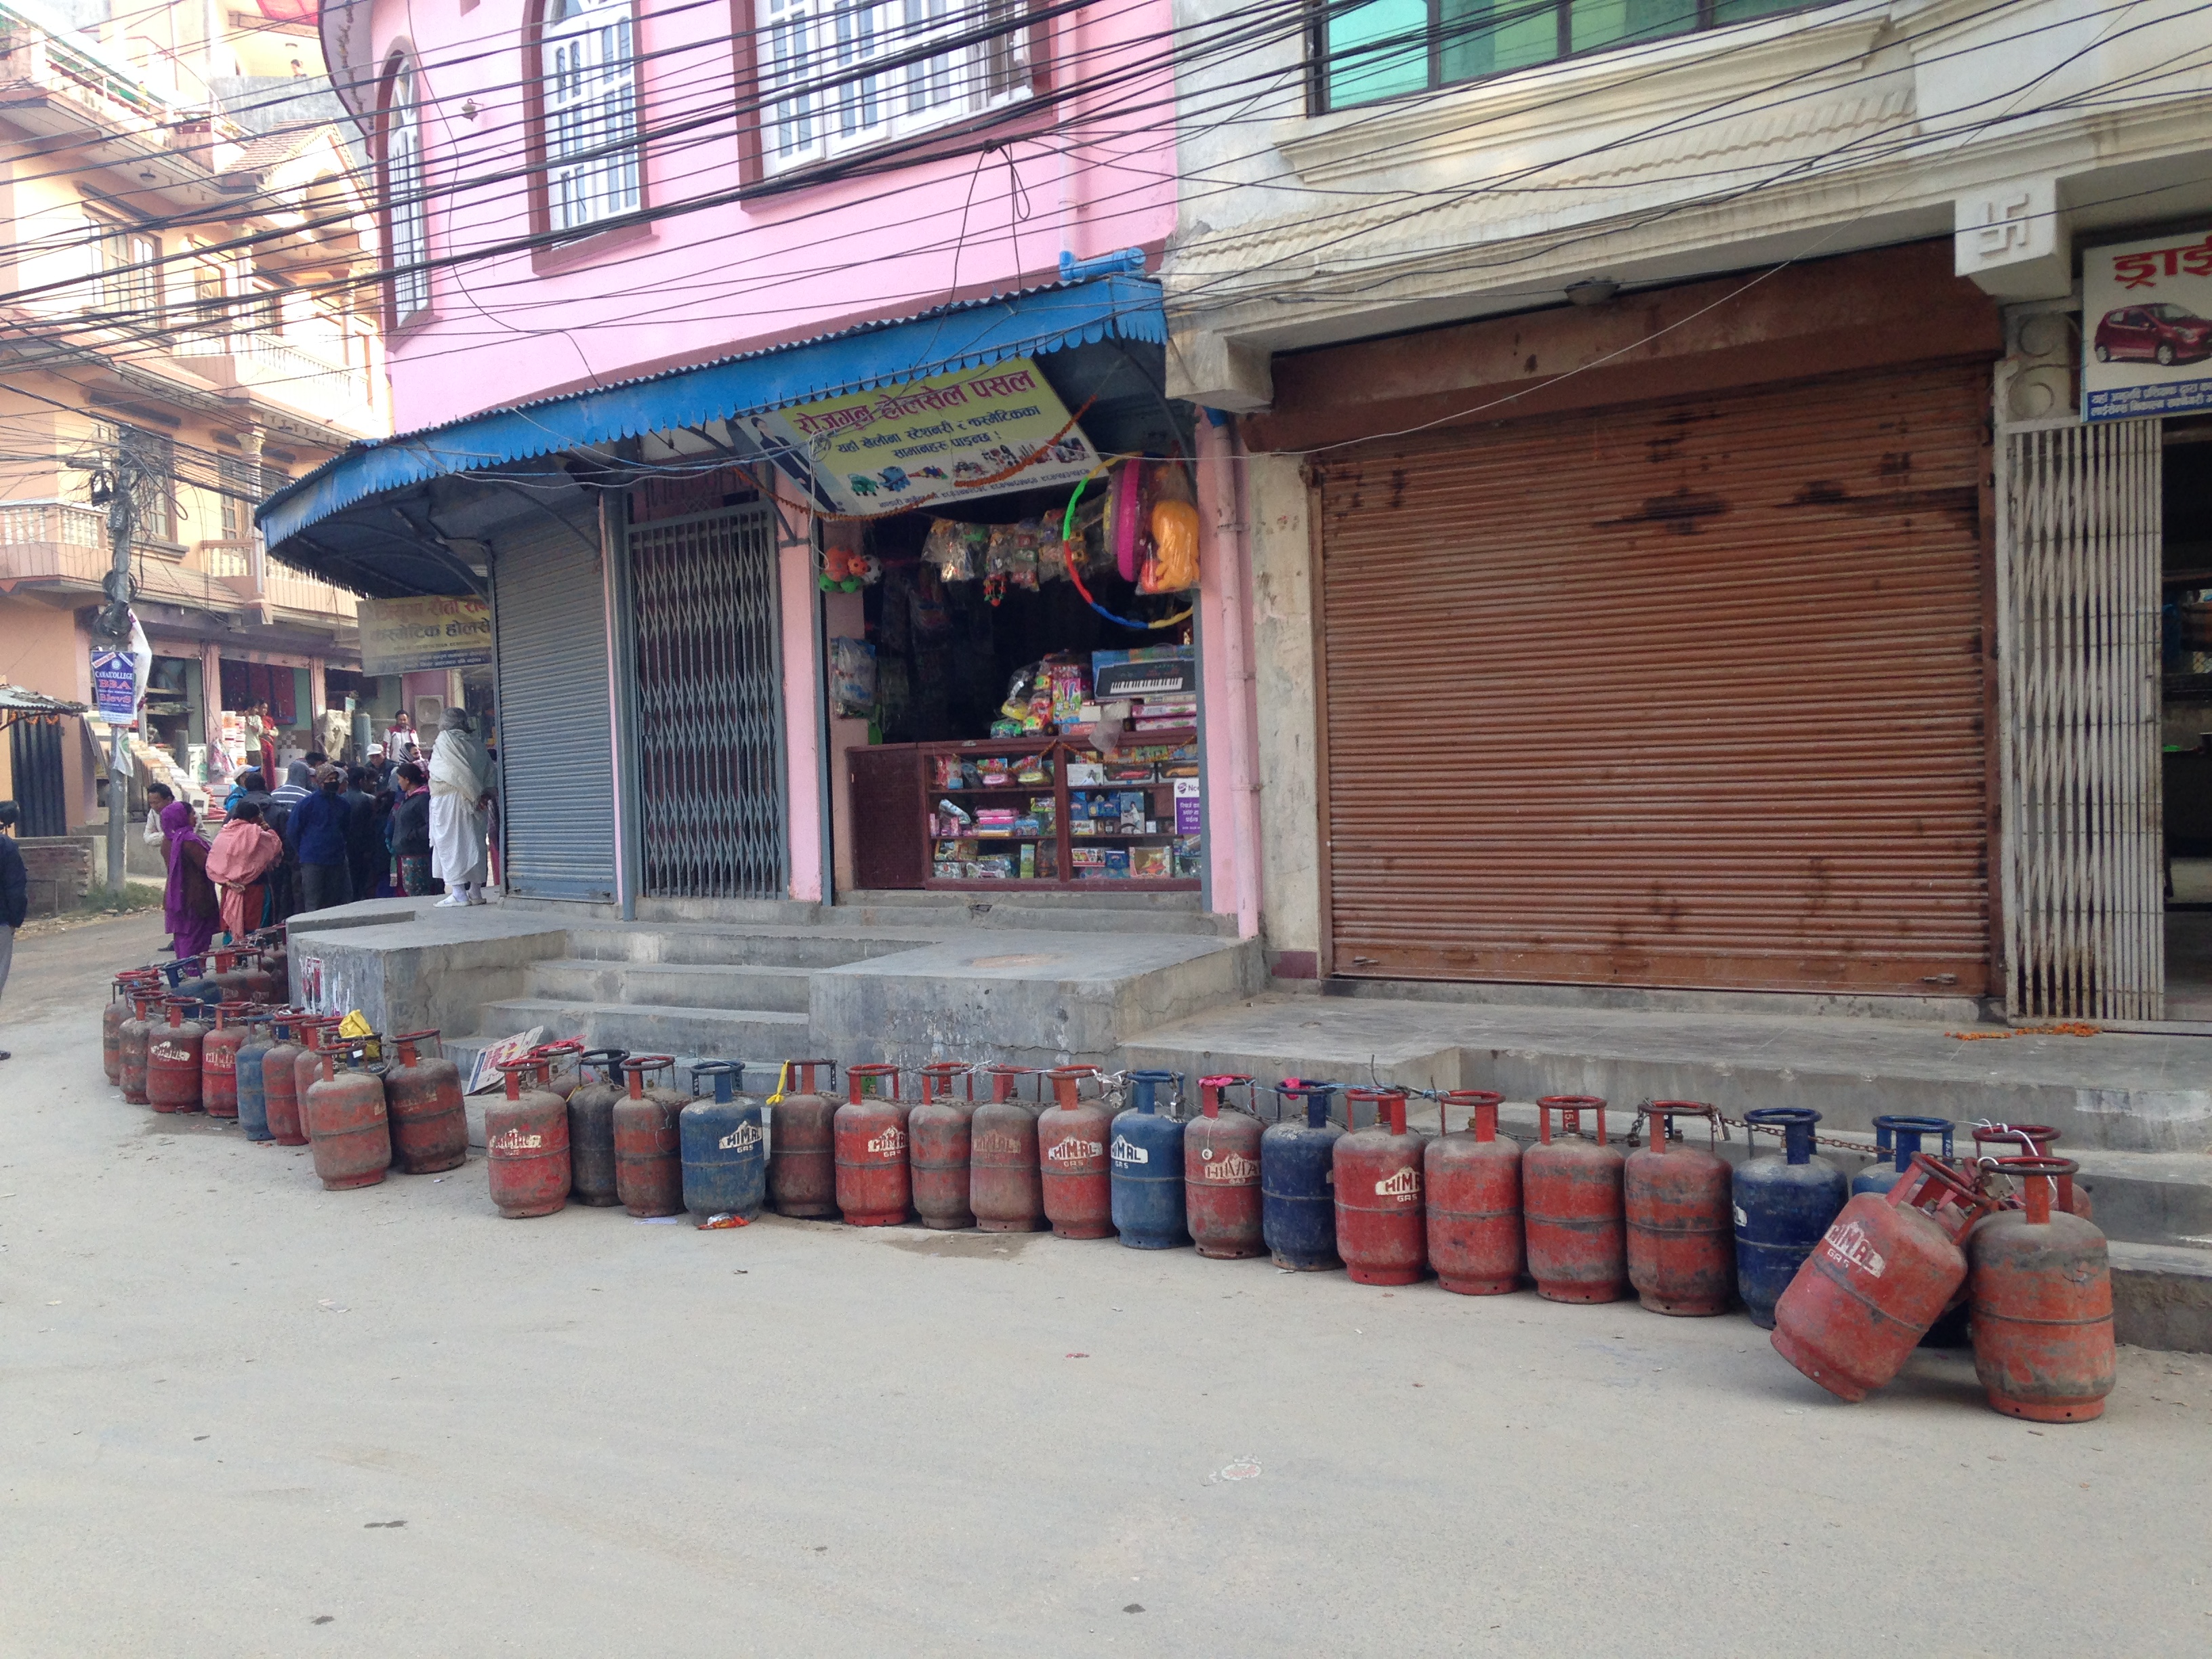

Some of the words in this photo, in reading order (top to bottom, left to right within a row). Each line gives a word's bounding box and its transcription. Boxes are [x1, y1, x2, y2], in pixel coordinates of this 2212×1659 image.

[968, 369, 1037, 398] पसल
[726, 1128, 761, 1146] HIMAL
[737, 1145, 754, 1153] GAS
[1054, 1141, 1098, 1158] HIMAL
[1115, 1160, 1129, 1169] GAS
[1397, 1193, 1418, 1202] GAS
[1828, 1225, 1875, 1270] HIMAL
